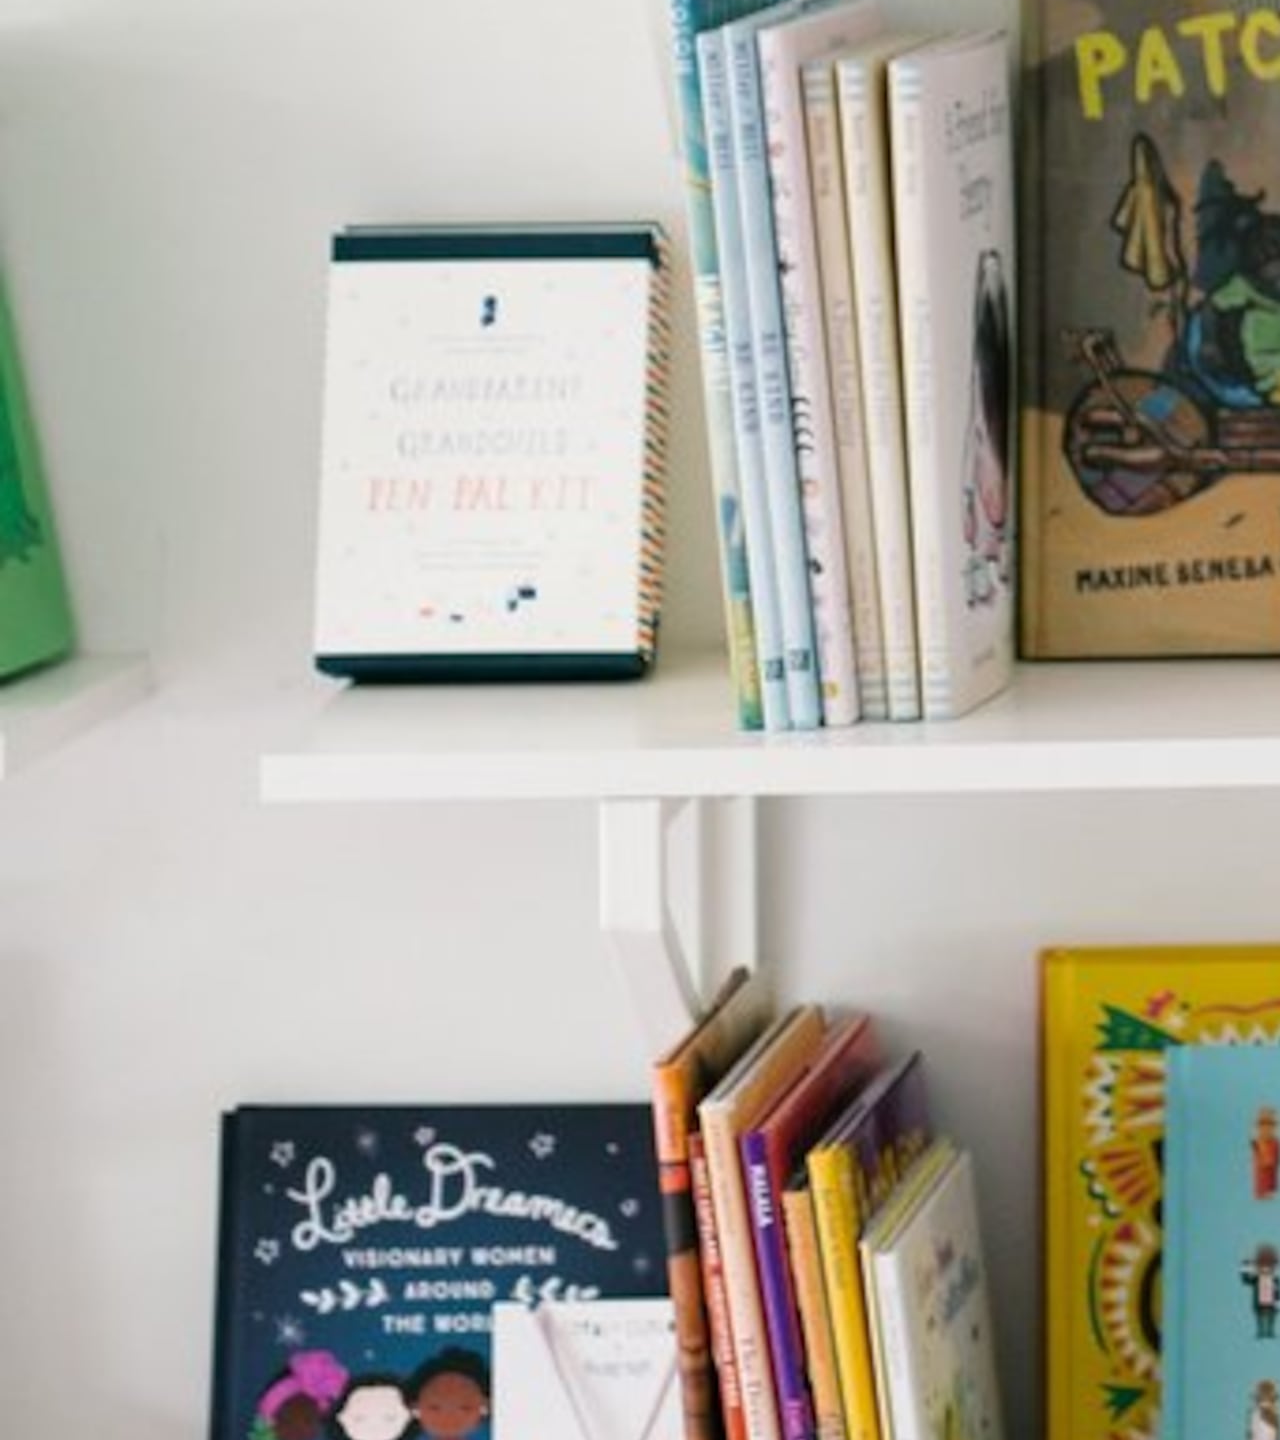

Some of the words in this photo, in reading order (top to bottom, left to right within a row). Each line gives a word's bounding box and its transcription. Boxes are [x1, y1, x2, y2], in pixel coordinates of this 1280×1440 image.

[365, 476, 432, 512] PEN
[451, 476, 511, 512] PAL
[1075, 565, 1169, 593] MAXINE
[1176, 558, 1271, 587] BENEBA
[286, 1155, 413, 1250] Little
[415, 1142, 618, 1251] Dreamers
[341, 1246, 462, 1270] VISIONARY
[470, 1245, 557, 1267] WOMEN
[403, 1279, 495, 1302] AROUND
[381, 1313, 425, 1334] THE
[433, 1313, 493, 1334] WOR
